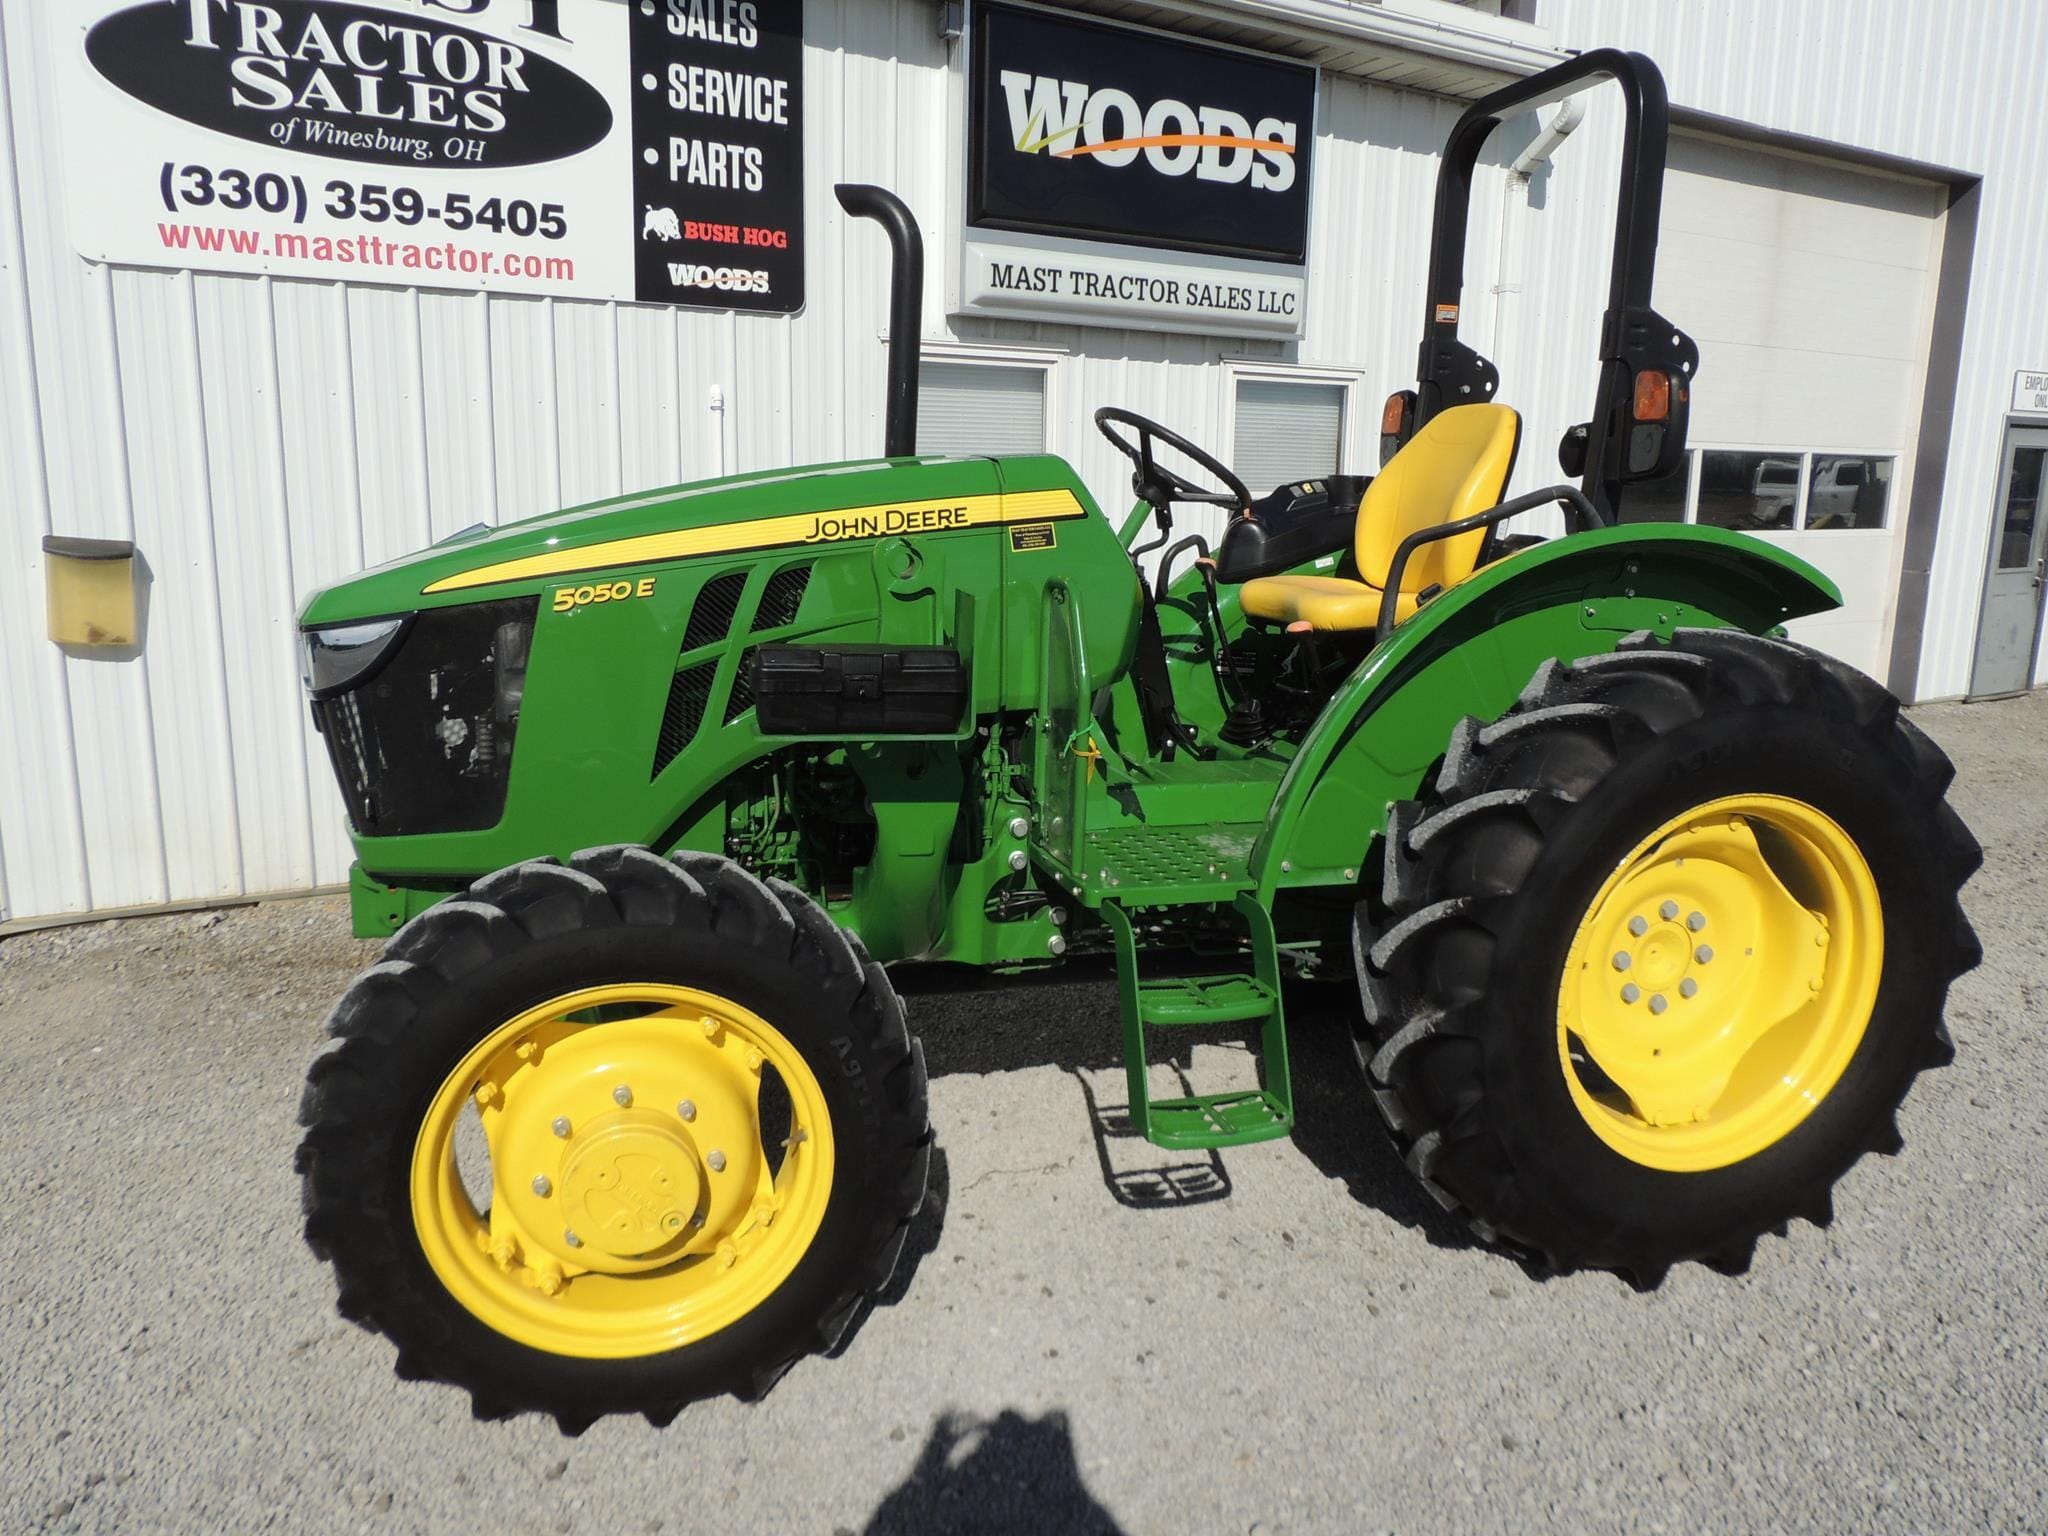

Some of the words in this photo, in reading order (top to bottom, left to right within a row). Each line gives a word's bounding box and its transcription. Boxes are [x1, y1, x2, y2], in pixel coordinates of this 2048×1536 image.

[173, 0, 530, 92] TRACTOR
[667, 0, 758, 48] SALES
[230, 55, 507, 133] SALES
[667, 63, 788, 125] SERVICE
[270, 117, 300, 145] of
[304, 119, 433, 160] Winesburg,
[443, 136, 487, 161] OH
[1000, 70, 1297, 192] WOODS
[669, 136, 763, 192] PARTS
[159, 161, 308, 223] (330)
[324, 180, 568, 239] 359-5405
[157, 223, 575, 280] www.masttractor.com
[684, 220, 739, 244] BUSH
[743, 227, 787, 249] HOG
[990, 263, 1062, 294] MAST
[1070, 271, 1180, 305] TRACTOR
[1186, 282, 1252, 312] SALES
[1257, 289, 1296, 315] LLC
[806, 517, 878, 540] JOHN
[886, 507, 968, 532] DEERE
[553, 581, 633, 612] 5050
[636, 577, 656, 598] E
